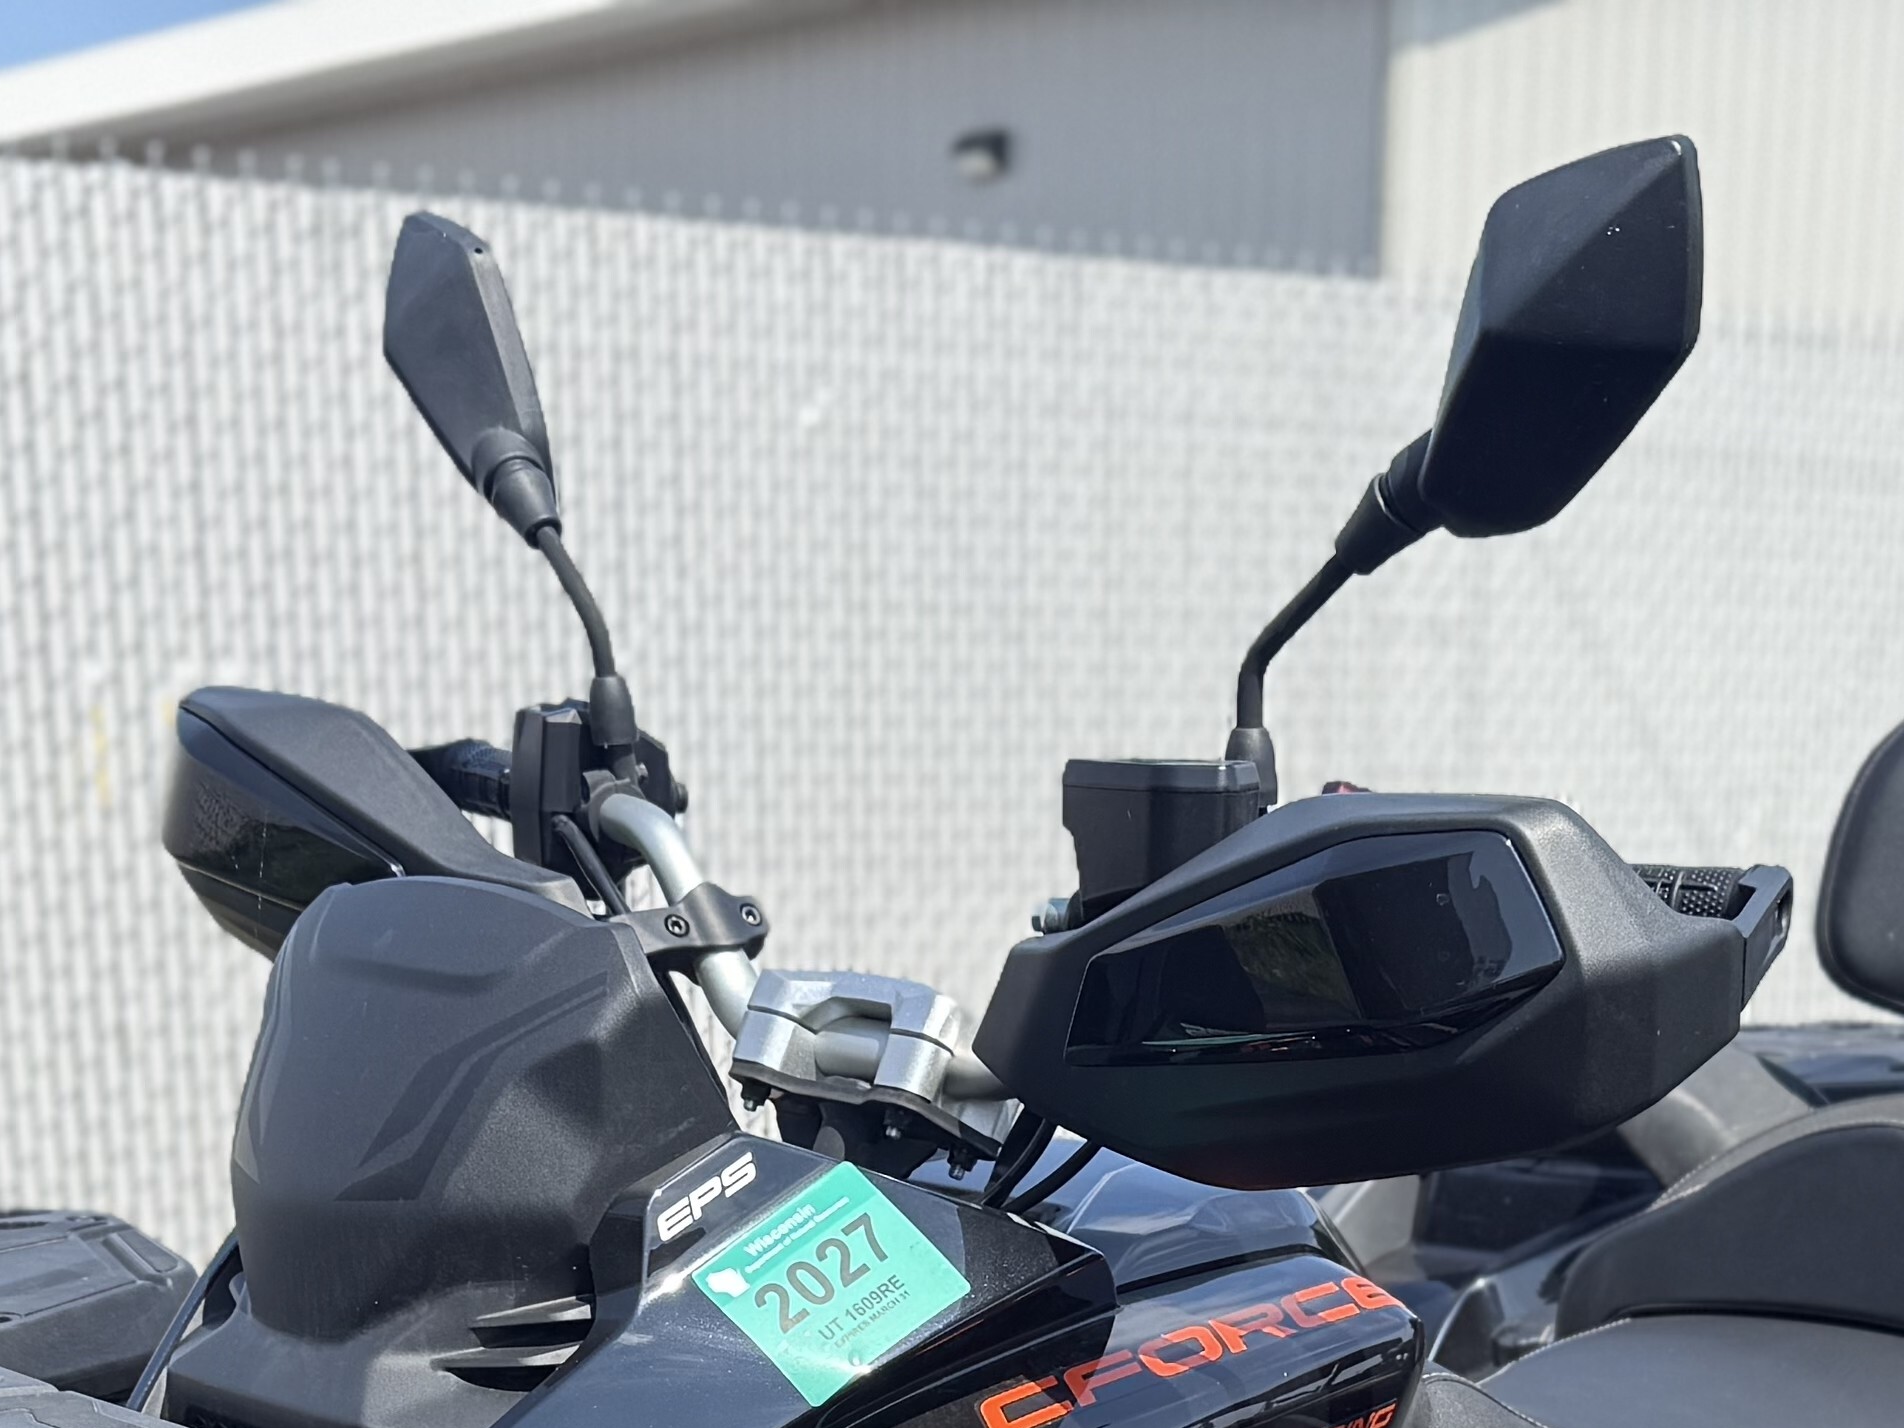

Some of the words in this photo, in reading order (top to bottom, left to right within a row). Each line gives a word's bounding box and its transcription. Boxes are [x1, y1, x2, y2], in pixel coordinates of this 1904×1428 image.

[656, 1151, 758, 1242] EPS
[743, 1202, 817, 1258] Wisconsin
[754, 1211, 889, 1336] 2027
[817, 1311, 846, 1341] UT
[845, 1274, 906, 1323] 1609RE
